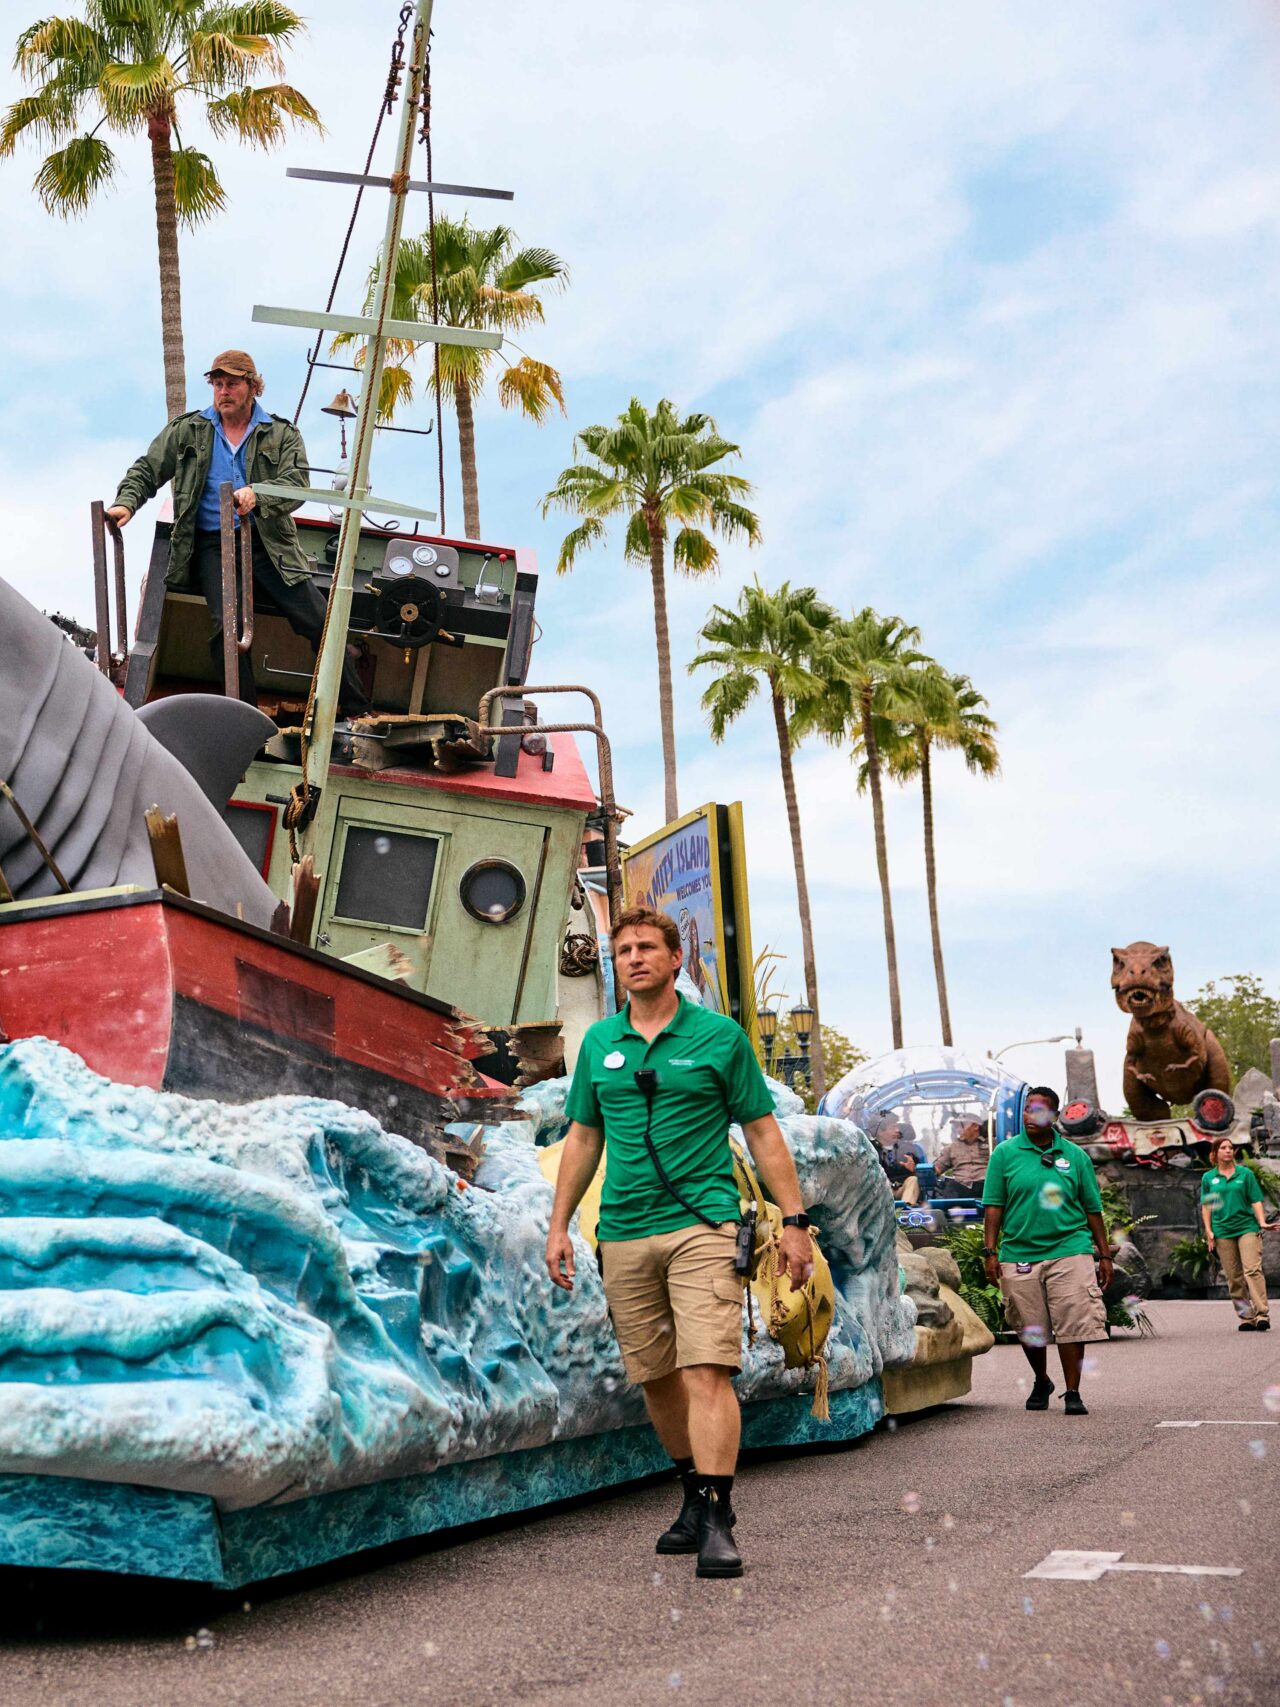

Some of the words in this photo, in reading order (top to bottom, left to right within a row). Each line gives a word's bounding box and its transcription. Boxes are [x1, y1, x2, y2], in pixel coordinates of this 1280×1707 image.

[646, 848, 674, 911] AMITY
[675, 835, 710, 874] ISLAND
[676, 877, 701, 901] WELCOMES
[702, 872, 712, 893] YOU
